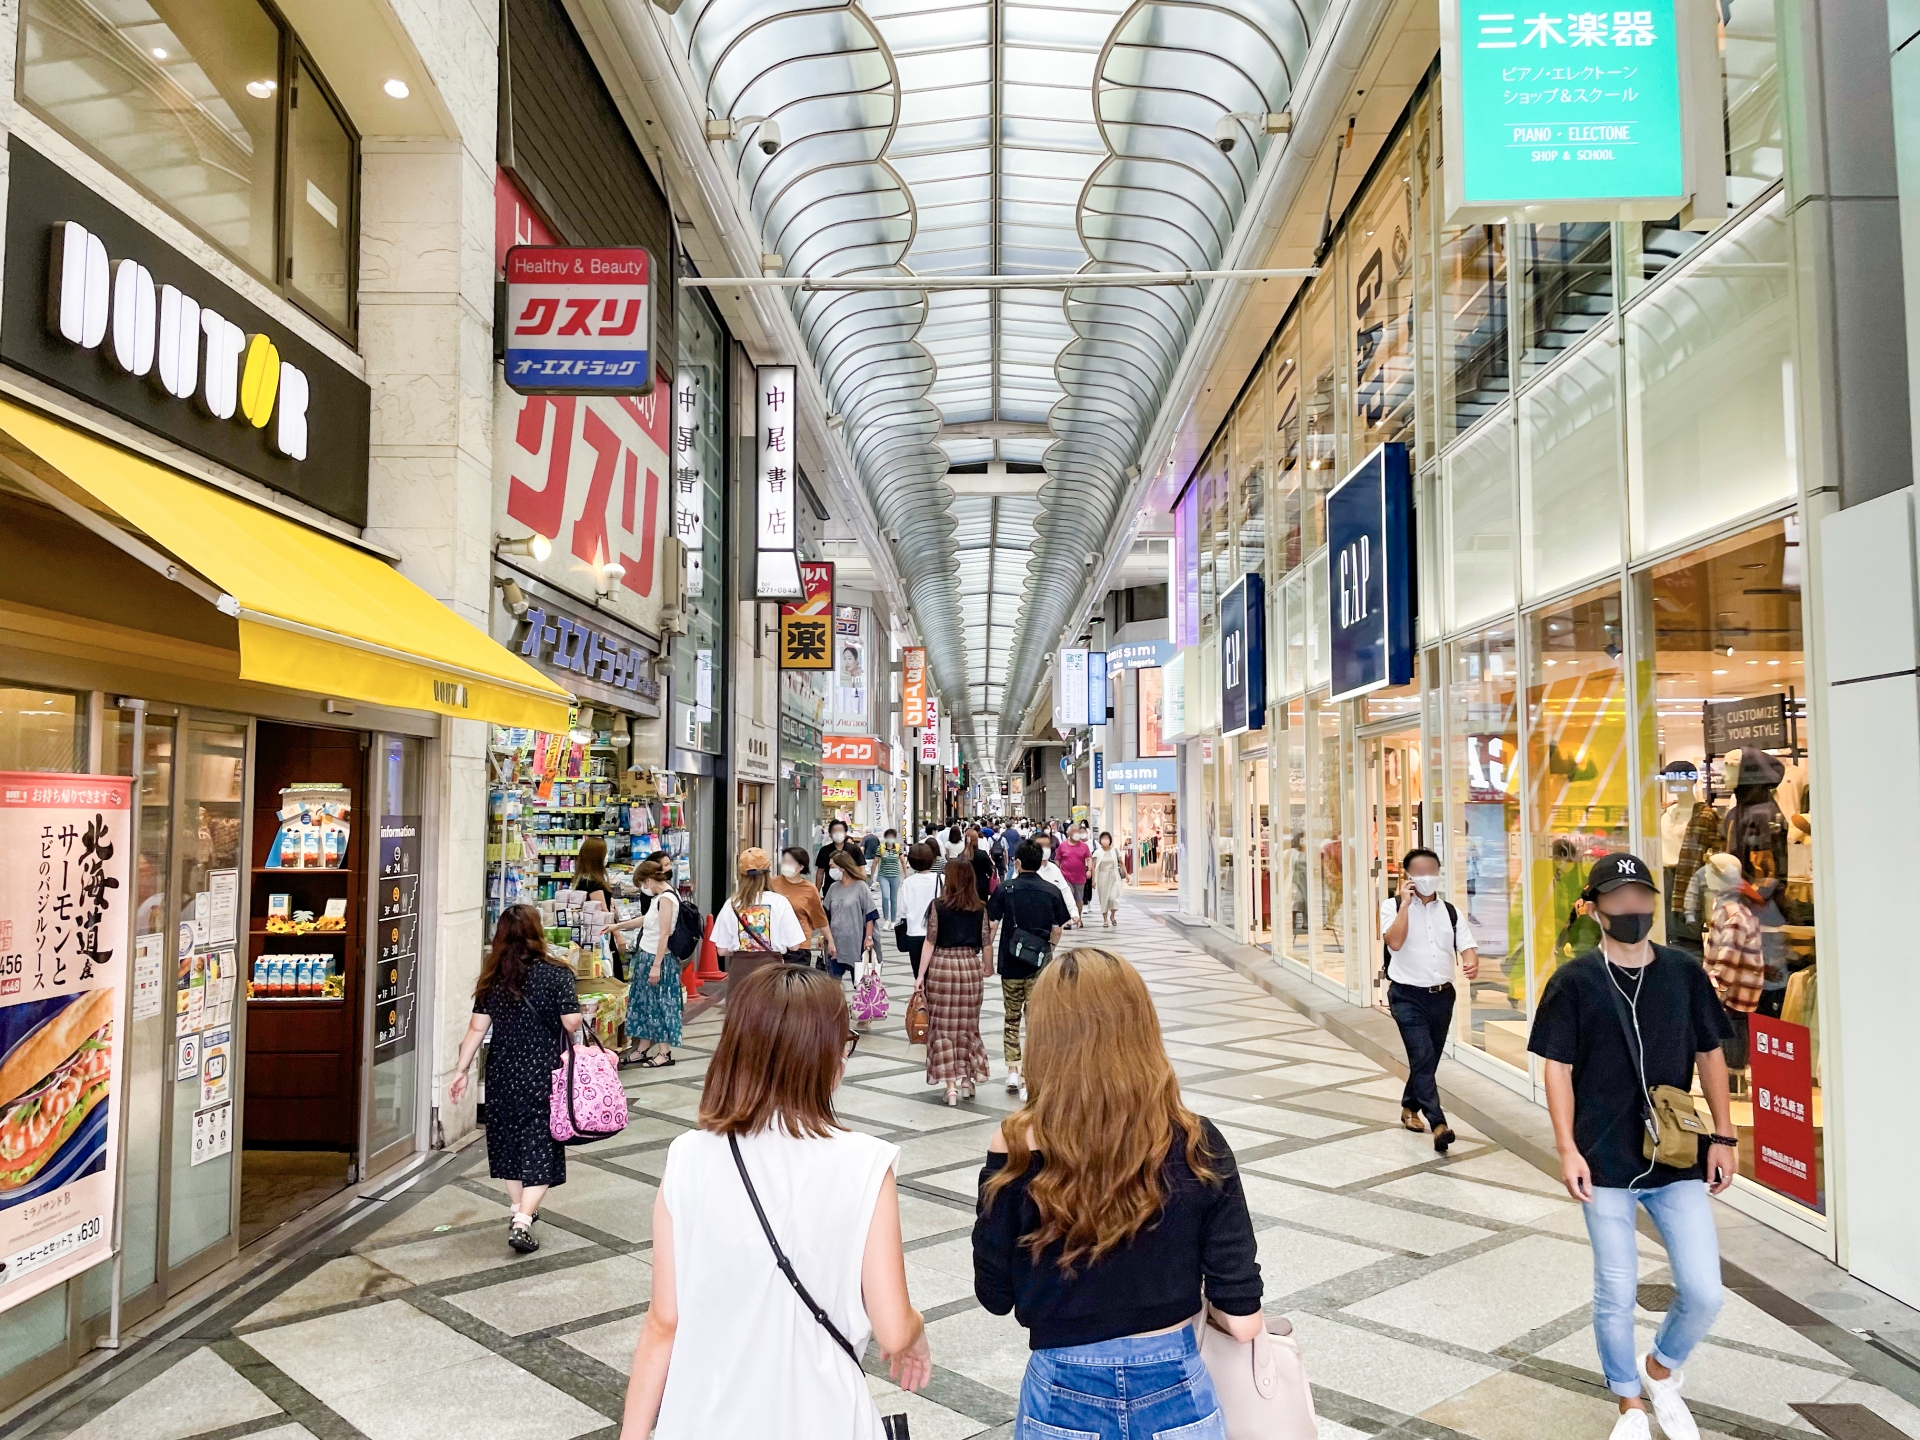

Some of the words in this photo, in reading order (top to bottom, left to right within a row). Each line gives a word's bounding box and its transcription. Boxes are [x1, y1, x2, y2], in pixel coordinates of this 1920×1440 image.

[1477, 11, 1659, 49] 三木楽器
[1502, 66, 1638, 82] ピアノ・エレクトーン
[1502, 88, 1639, 105] ショップ&スクール
[1513, 127, 1552, 142] PIANO
[1568, 125, 1631, 141] ELECTONE
[1531, 150, 1558, 162] SHOP
[1562, 152, 1571, 161] &
[1576, 149, 1616, 161] SCHOOL
[515, 258, 569, 275] Healthy
[573, 258, 584, 274] &
[590, 259, 643, 275] Beauty
[514, 298, 642, 336] クスリ
[53, 219, 310, 462] DOUTOR
[513, 359, 641, 376] オーエスドラッグ
[766, 386, 786, 536] 中尾書店
[802, 567, 829, 582] ルハ
[1340, 534, 1370, 630] GAP
[521, 606, 645, 691] オーエスドラッグ
[787, 621, 826, 660] 薬
[1225, 628, 1241, 690] GAP
[836, 719, 868, 728] SHISEIDO
[1726, 705, 1779, 724] CUSTOMIZE
[922, 702, 937, 760] スギ薬局
[1727, 729, 1751, 741] YOUR
[1752, 725, 1780, 738] STYLE
[31, 788, 110, 805] お持ち帰りできます
[380, 825, 416, 838] information
[1616, 859, 1637, 874] NY
[32, 825, 54, 991] エビのバジルソース
[53, 824, 79, 986] サーモンと
[77, 1217, 100, 1242] ¥630
